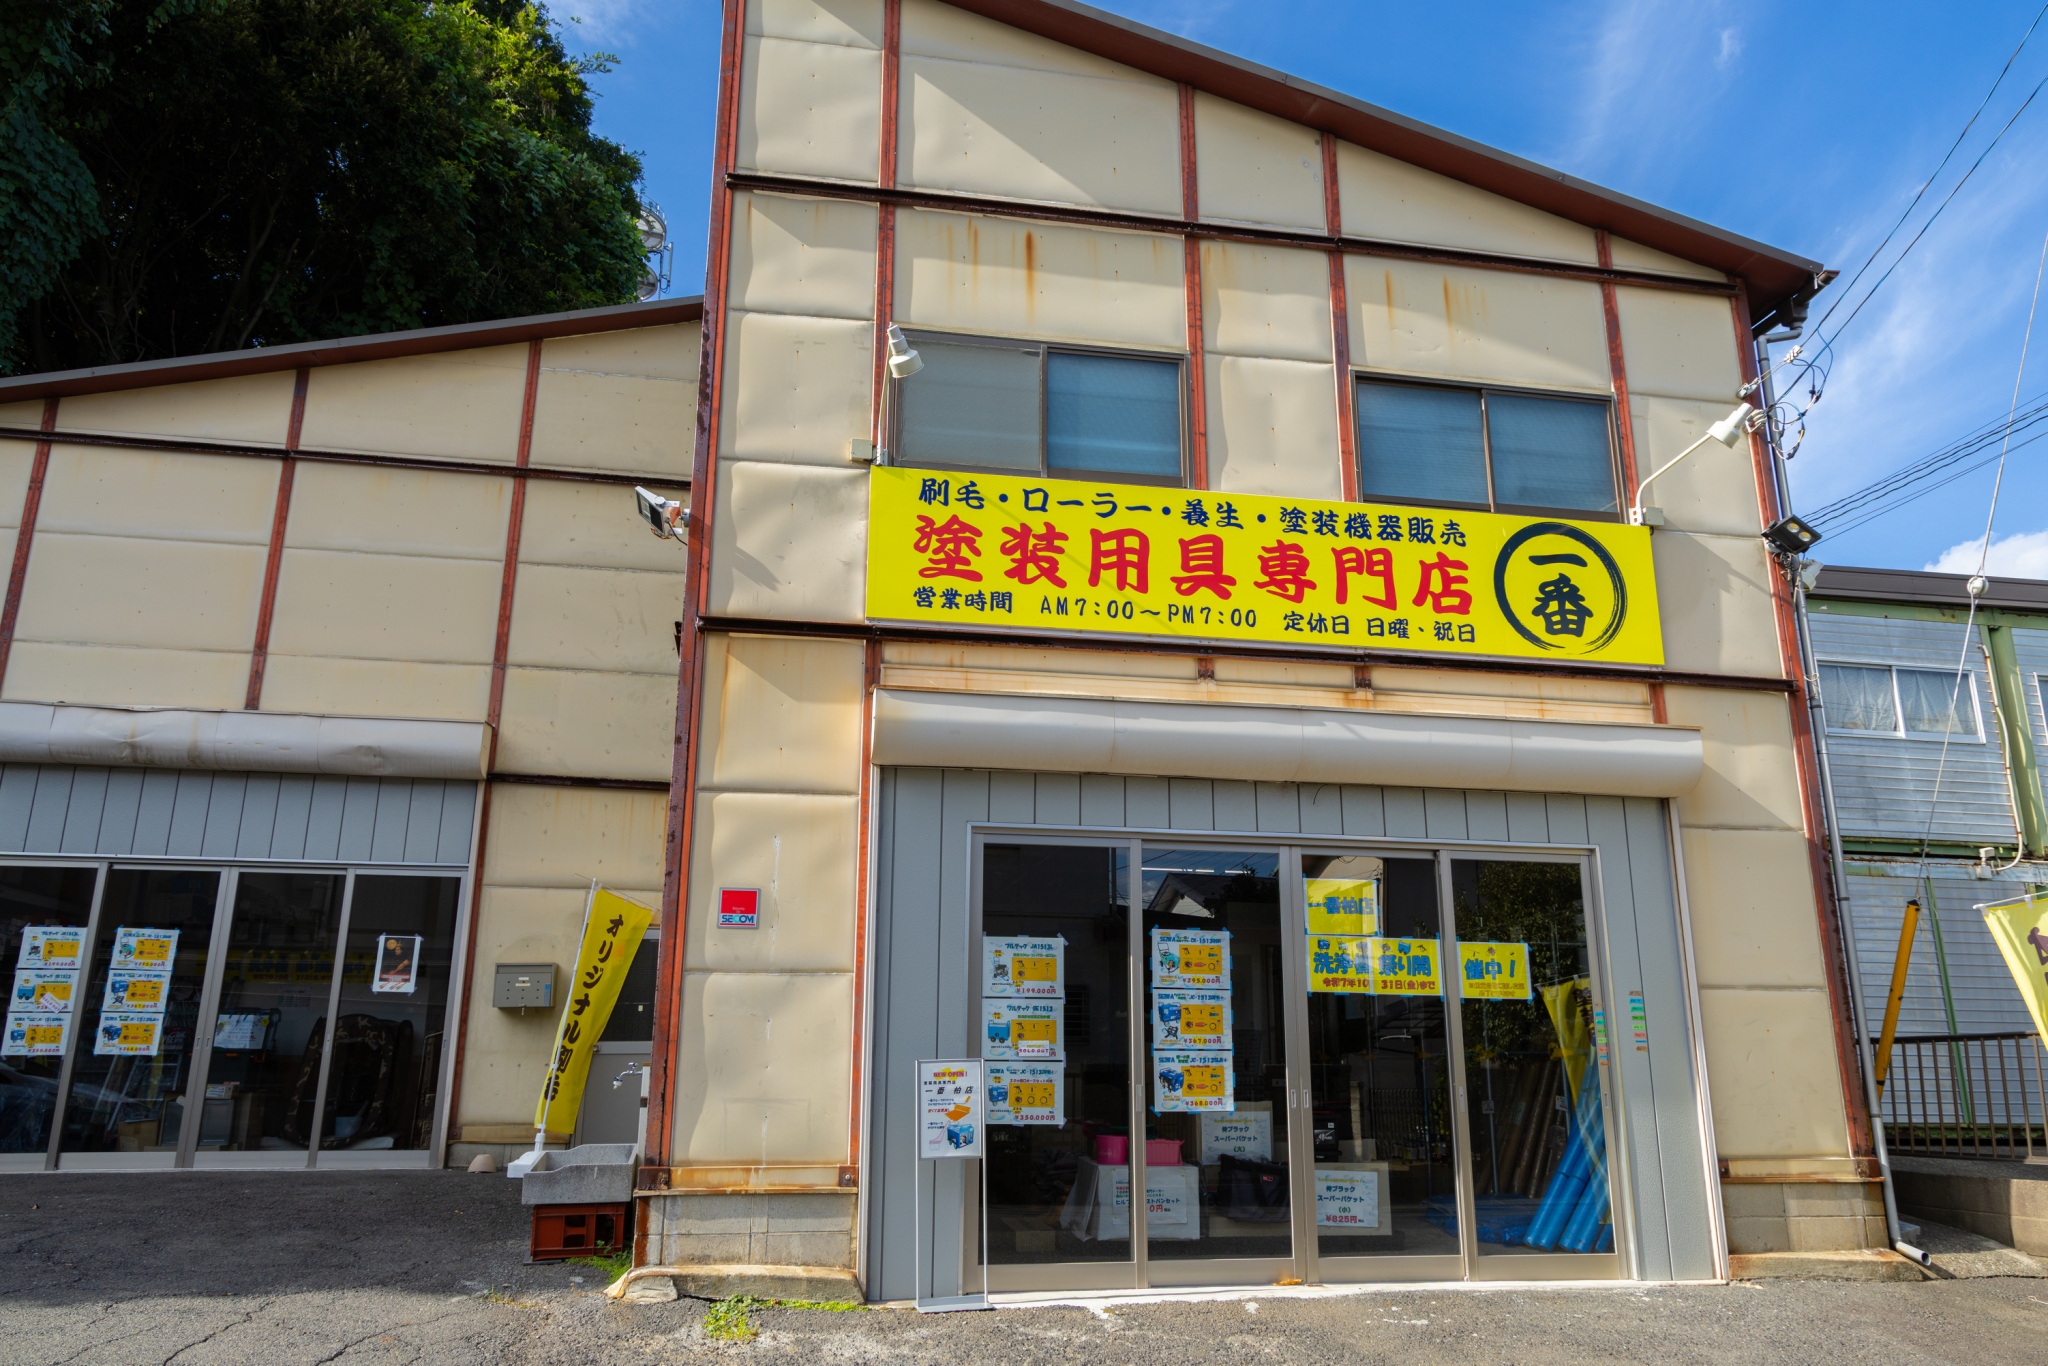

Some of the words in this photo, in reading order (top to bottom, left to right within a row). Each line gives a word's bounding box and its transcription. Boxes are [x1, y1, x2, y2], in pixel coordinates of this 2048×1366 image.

[913, 514, 1473, 616] 塗装用具専門店
[913, 586, 1013, 614] 営業時間
[1283, 611, 1350, 635] 定休日
[1527, 552, 1594, 638] 一番
[722, 914, 755, 923] SECOM
[1307, 896, 1374, 914] 一番柏店
[933, 1070, 947, 1078] NEW
